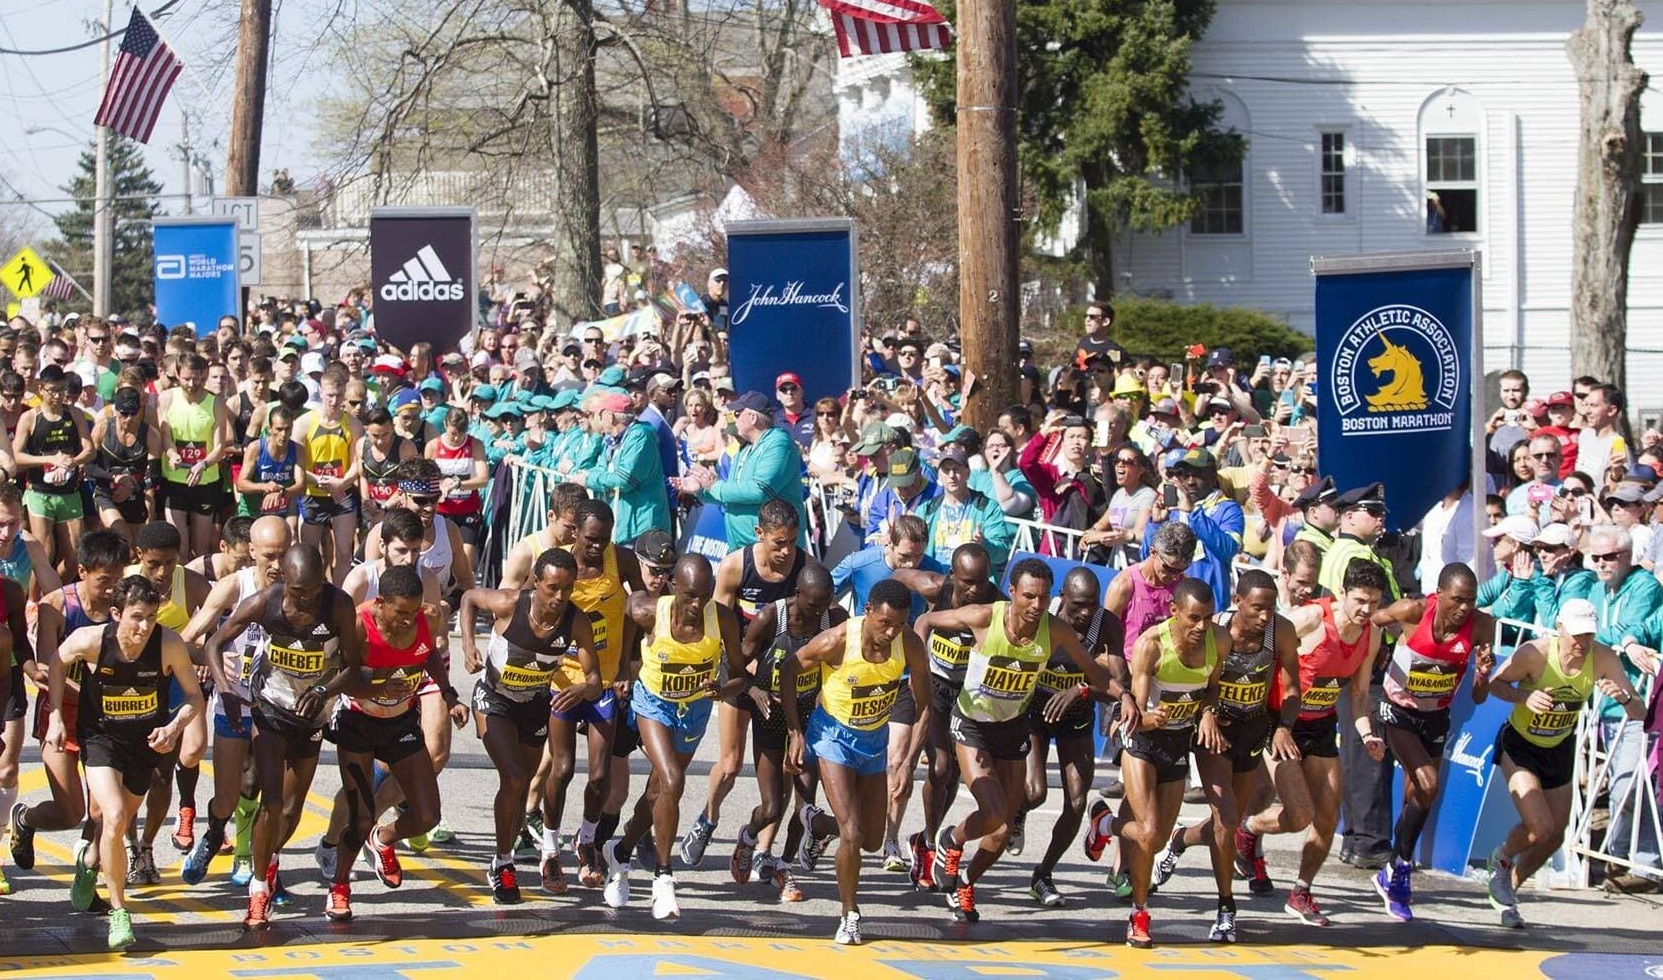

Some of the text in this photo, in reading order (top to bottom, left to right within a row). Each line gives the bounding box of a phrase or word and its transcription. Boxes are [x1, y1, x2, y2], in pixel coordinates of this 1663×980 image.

[189, 264, 234, 273] MARATHON
[189, 271, 221, 279] MAJORS
[381, 279, 463, 301] adidas
[989, 290, 998, 302] 2
[731, 280, 849, 325] John Hancock
[1337, 310, 1456, 407] BOSTON ATHLETIC ASSOCIATION
[1342, 413, 1452, 431] BOSTON MARATHON
[181, 449, 201, 459] 129
[260, 471, 292, 480] BRASIL
[270, 649, 323, 670] CHEBET
[983, 667, 1035, 692] HAYLE
[104, 697, 157, 713] BURRELL
[851, 692, 896, 717] DESISA
[231, 942, 533, 963] BOSTON
